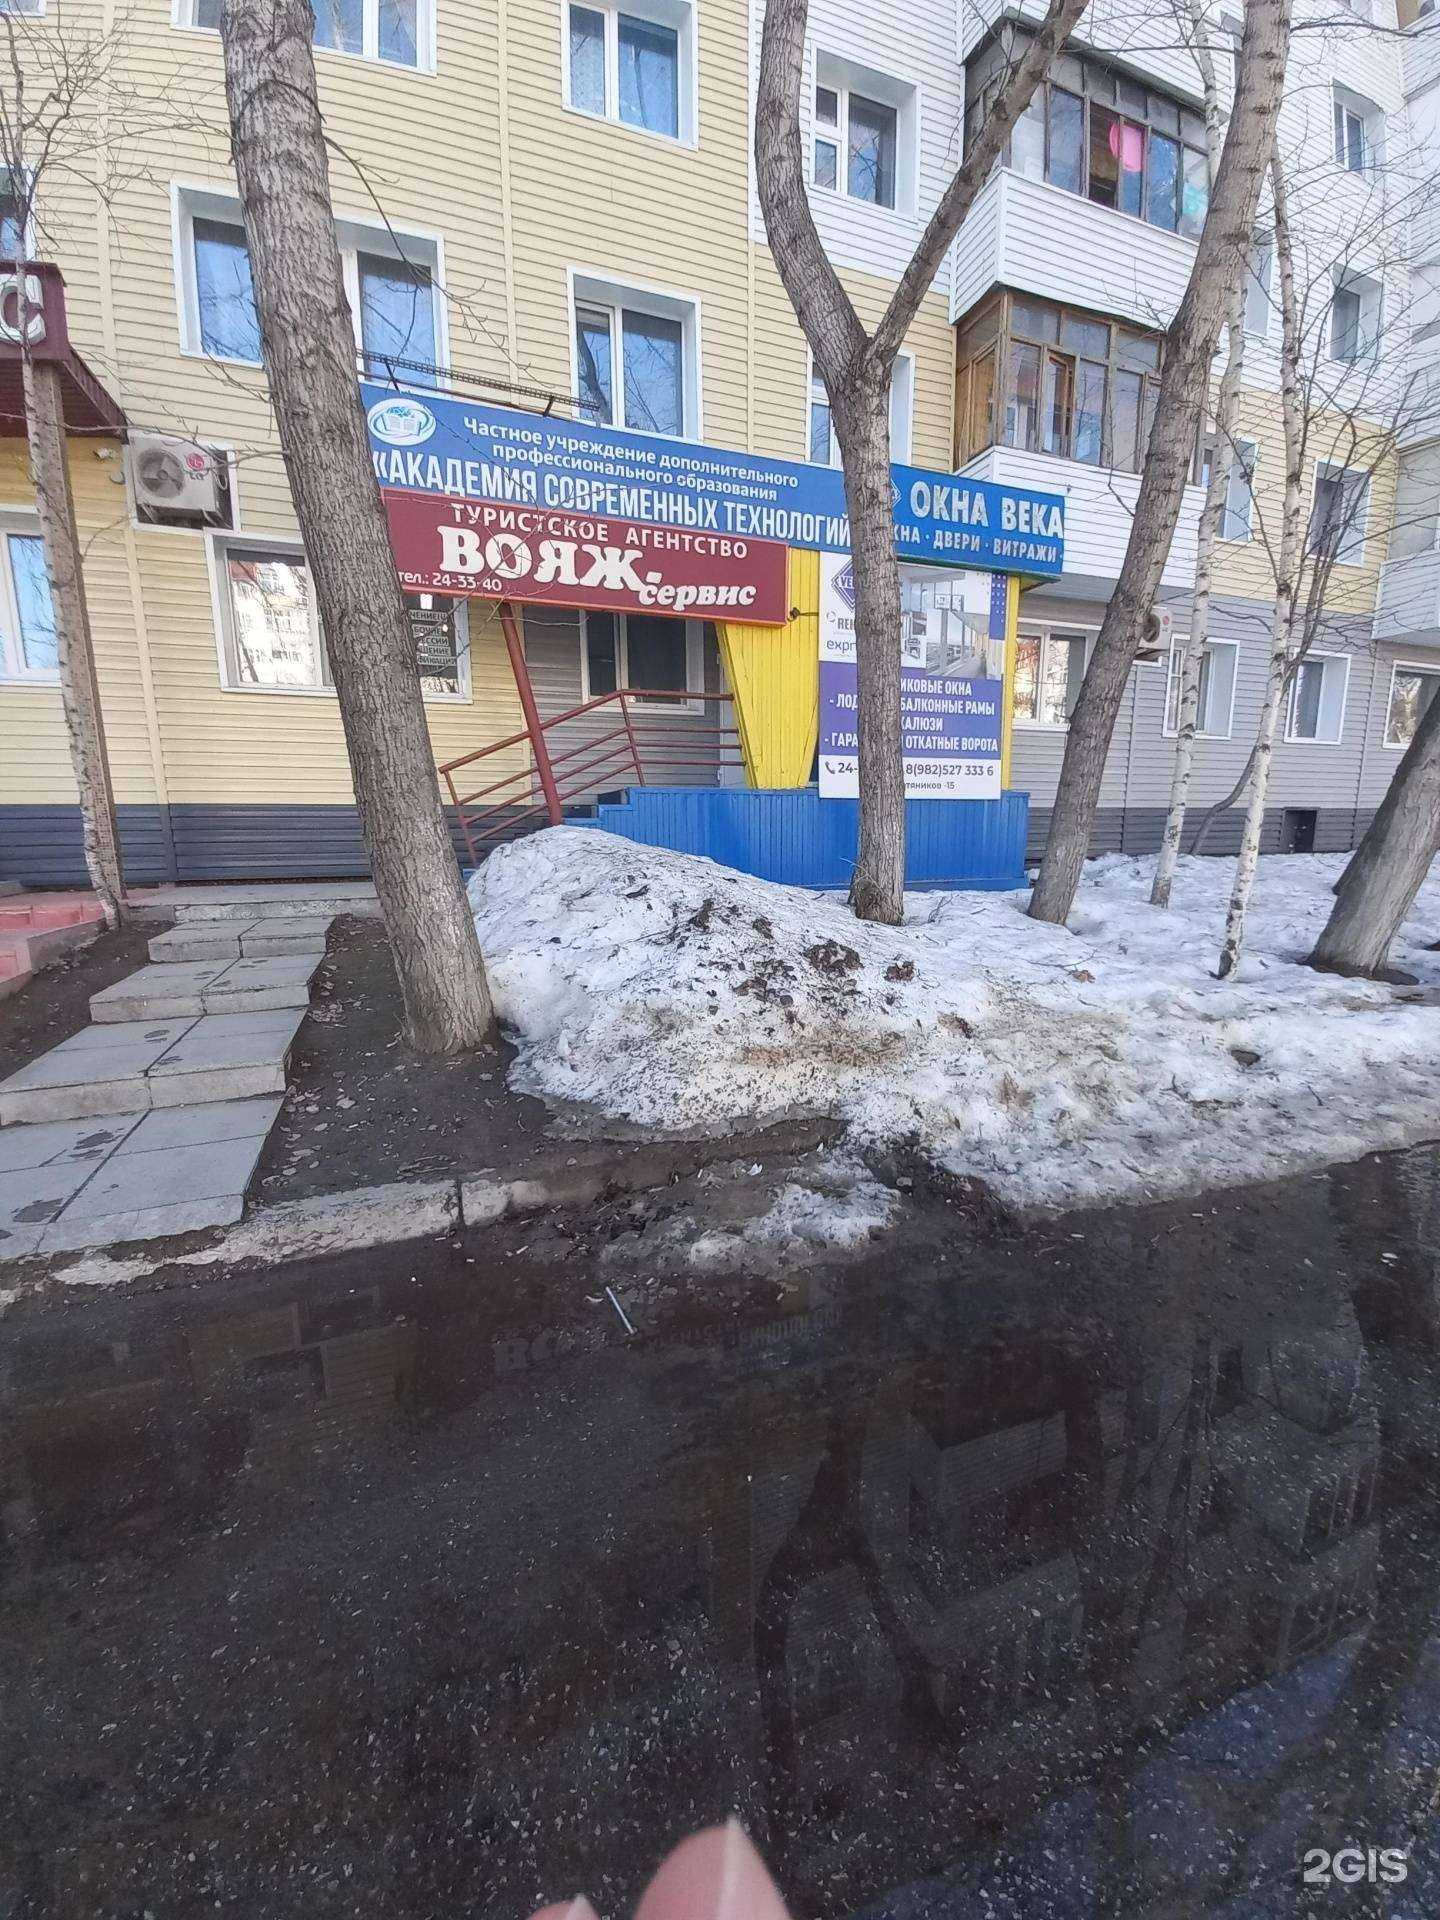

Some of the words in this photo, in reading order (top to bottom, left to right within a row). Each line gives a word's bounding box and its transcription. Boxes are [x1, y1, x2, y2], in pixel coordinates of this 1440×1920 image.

[463, 416, 542, 444] Частное
[546, 431, 656, 465] учреждение
[659, 454, 799, 488] дополнительного
[492, 444, 673, 485] профессионального
[676, 473, 778, 501] образования
[372, 448, 537, 505] «АКАДЕМИЯ
[544, 474, 718, 530] СОВРЕМЕННЫХ
[723, 500, 851, 548] ТЕХНОЛОГИЙ
[910, 480, 989, 528] ОКНА
[1001, 496, 1064, 540] ВЕКА
[450, 503, 609, 543] ТУРИСТСКОЕ
[625, 526, 748, 560] АГЕНТСТВО
[933, 529, 981, 552] ДВЕРИ
[993, 538, 1057, 563] ВИТРАЖИ
[432, 572, 502, 591] 24-33-40
[637, 581, 757, 612] сервис
[945, 681, 972, 696] ОКНА
[965, 701, 995, 716] РАМЫ
[905, 735, 960, 751] ОТКАТНЫЕ
[961, 737, 998, 752] ВОРОТА
[905, 763, 962, 778] 8(982)527
[964, 765, 984, 777] 333
